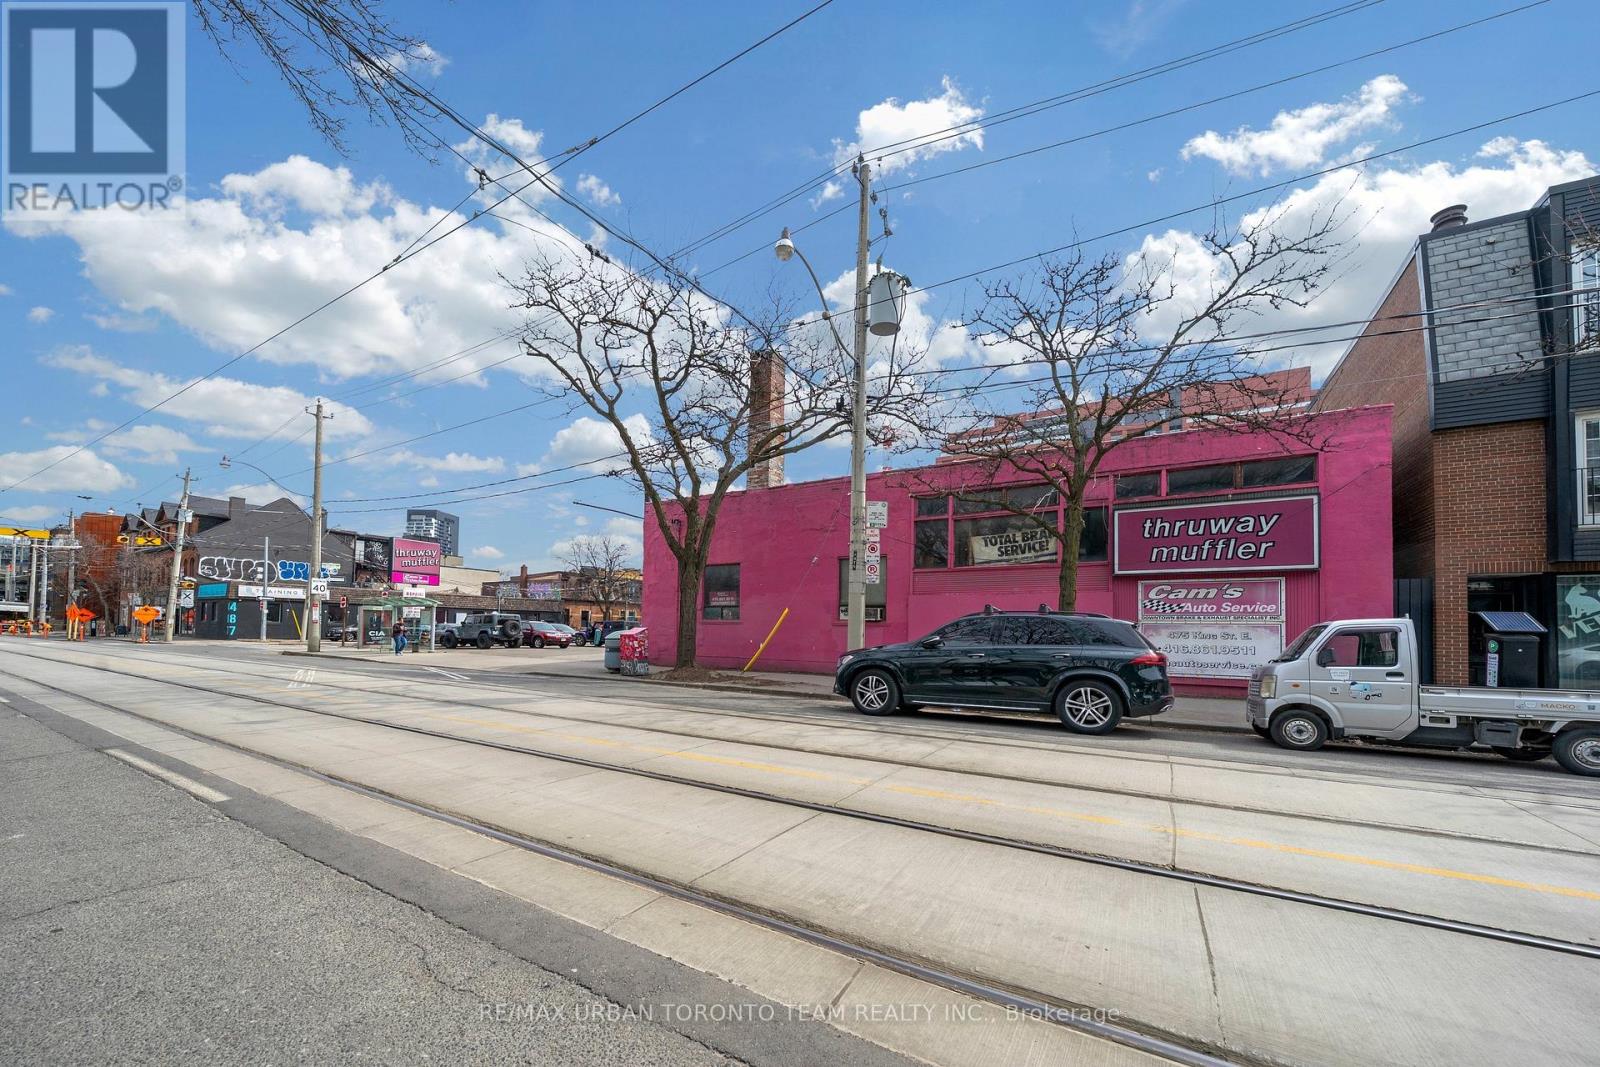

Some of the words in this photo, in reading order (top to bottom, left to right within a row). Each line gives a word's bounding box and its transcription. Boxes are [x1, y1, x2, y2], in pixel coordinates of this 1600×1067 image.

[1143, 512, 1282, 539] thruway
[982, 533, 1019, 547] TOTAL
[396, 548, 437, 558] thruway
[997, 540, 1050, 557] SERVICE!
[1150, 537, 1275, 563] muffler
[401, 558, 439, 567] muffler
[312, 584, 326, 593] 40
[1148, 583, 1245, 600] Cam's
[1181, 602, 1217, 613] Auto
[1220, 601, 1277, 613] Service
[1559, 614, 1600, 639] VE
